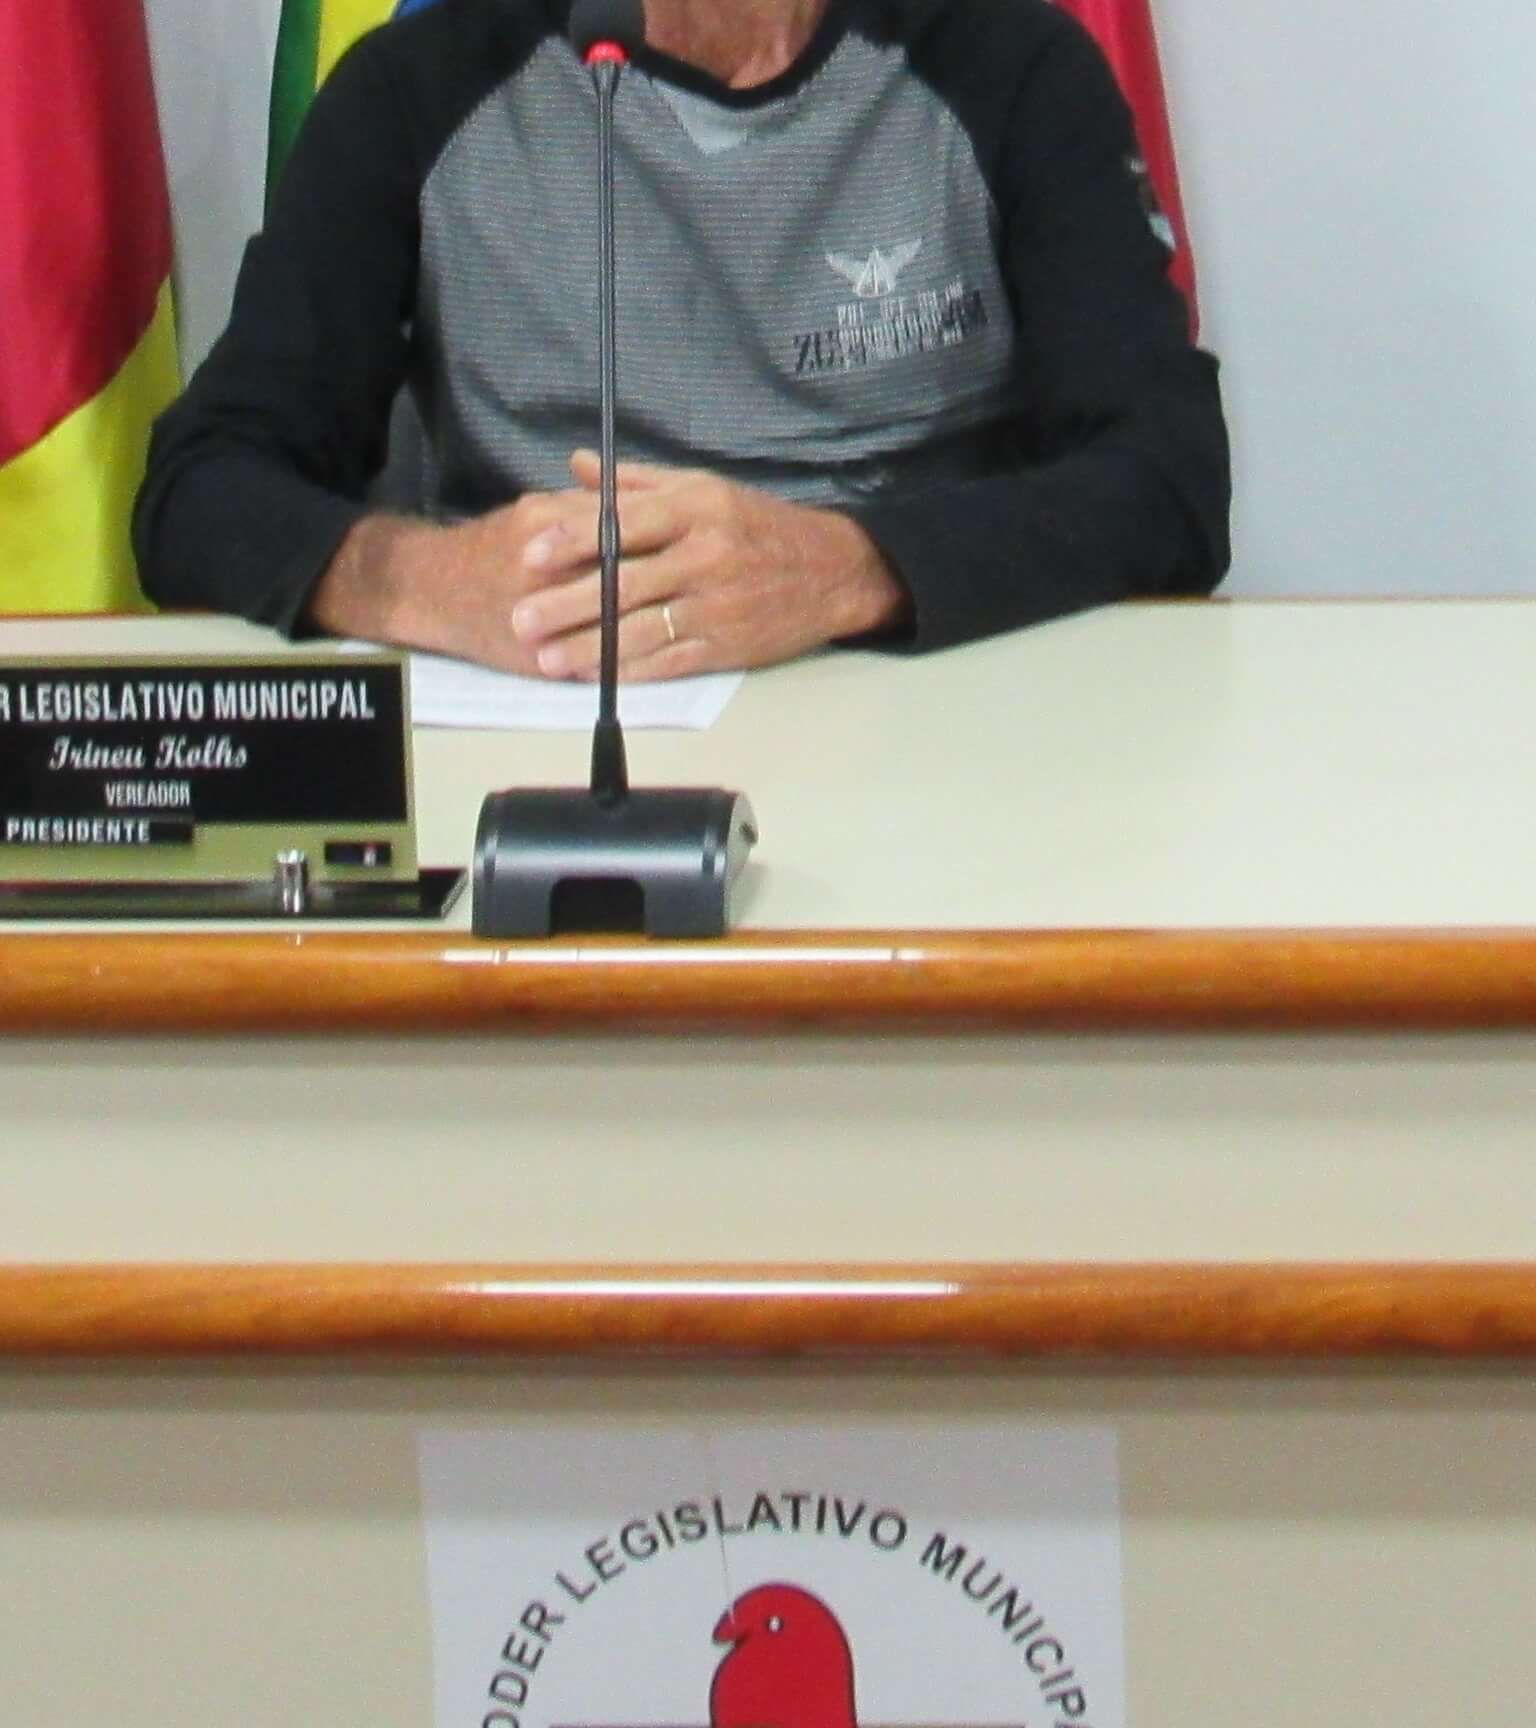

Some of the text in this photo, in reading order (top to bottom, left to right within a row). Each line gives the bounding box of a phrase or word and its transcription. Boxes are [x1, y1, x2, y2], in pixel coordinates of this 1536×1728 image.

[18, 681, 205, 722] LEGISLATIVO
[213, 680, 376, 721] MUNICIPAL
[48, 735, 146, 770] Irineu
[104, 780, 191, 808] VEREADOR
[4, 818, 151, 844] PRESIDENTE
[479, 1491, 1095, 1728] ODER LEGISLATIVO MUNICIP
